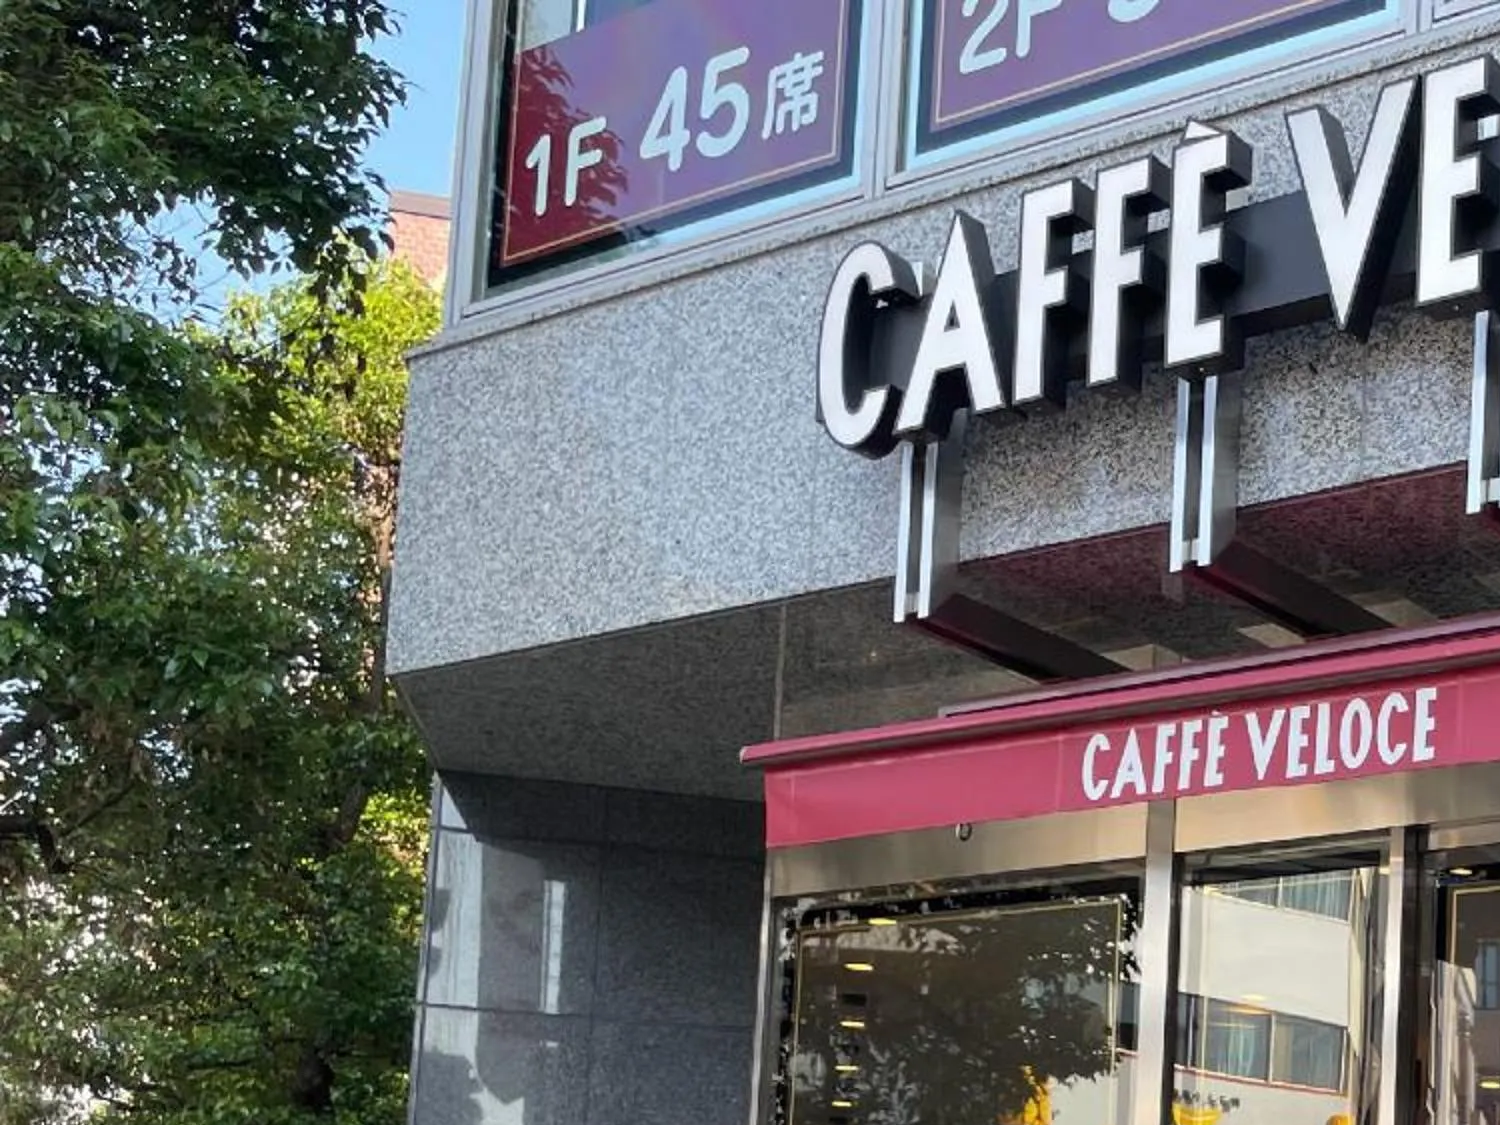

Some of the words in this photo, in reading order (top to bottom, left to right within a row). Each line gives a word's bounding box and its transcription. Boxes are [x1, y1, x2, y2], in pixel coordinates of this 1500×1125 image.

[524, 116, 608, 218] 1F
[638, 45, 825, 173] 45席
[1246, 687, 1438, 781] VELOCE
